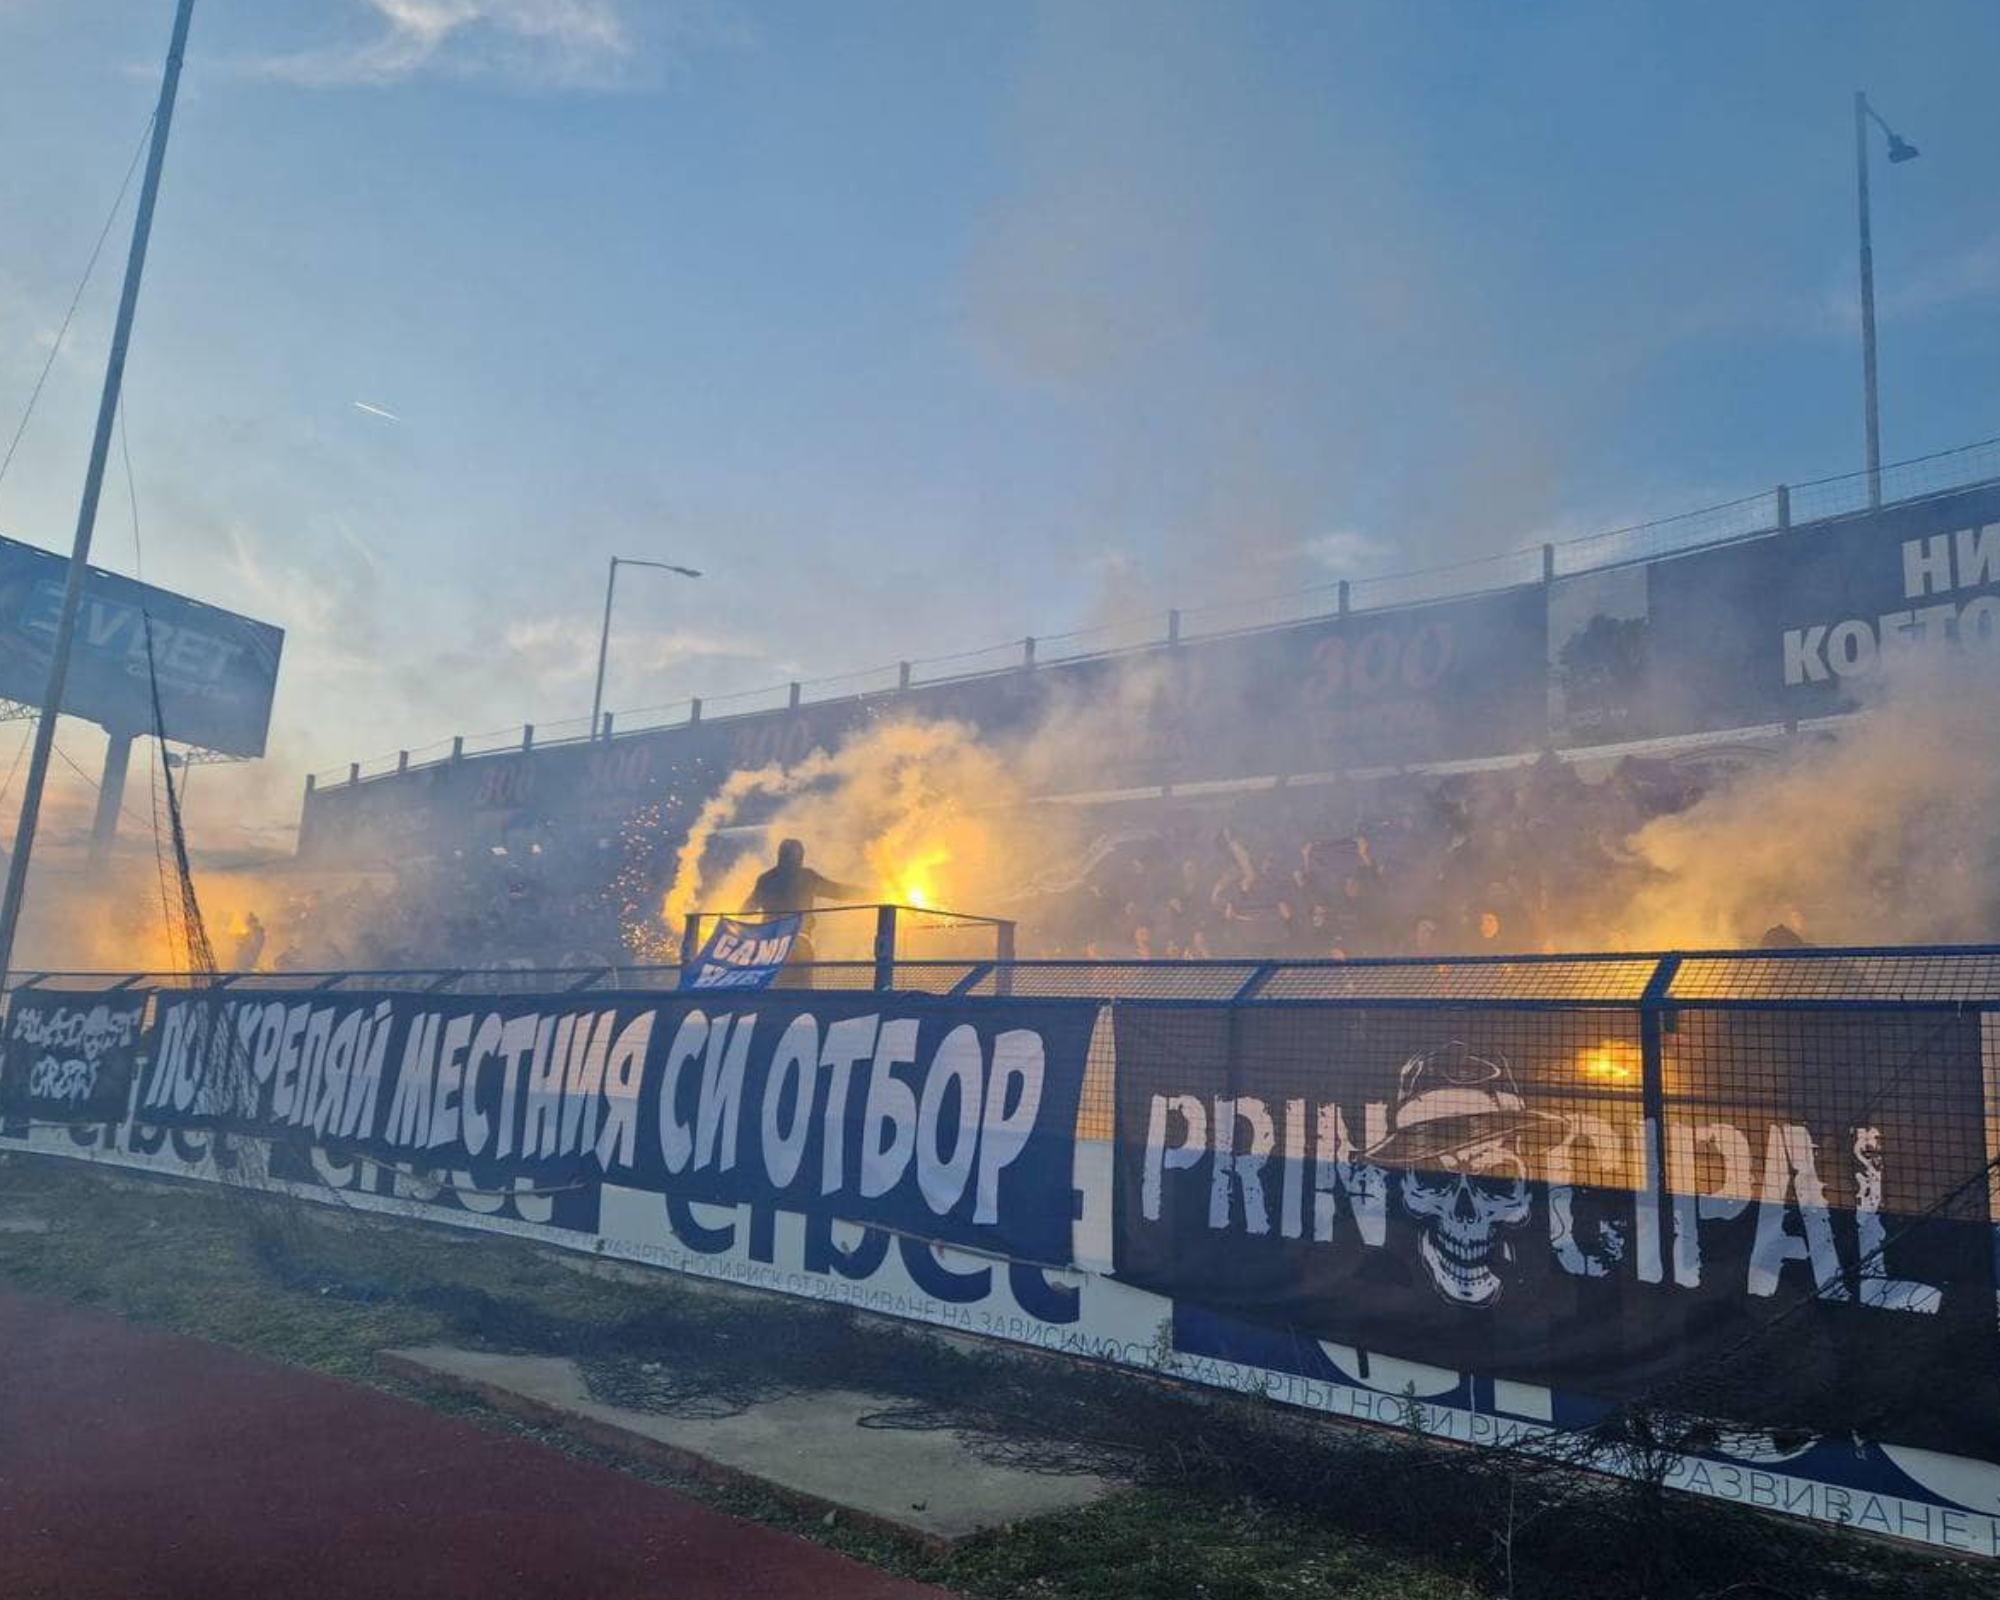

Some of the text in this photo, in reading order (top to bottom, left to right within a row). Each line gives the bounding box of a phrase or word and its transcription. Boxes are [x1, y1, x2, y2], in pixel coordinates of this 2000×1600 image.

[385, 1009, 657, 1172] МЕСТНИЯ
[659, 1009, 758, 1175] СИ
[761, 1011, 1045, 1225] ОТБОР
[941, 1302, 972, 1326] НА
[1350, 1389, 1453, 1432] НОИ
